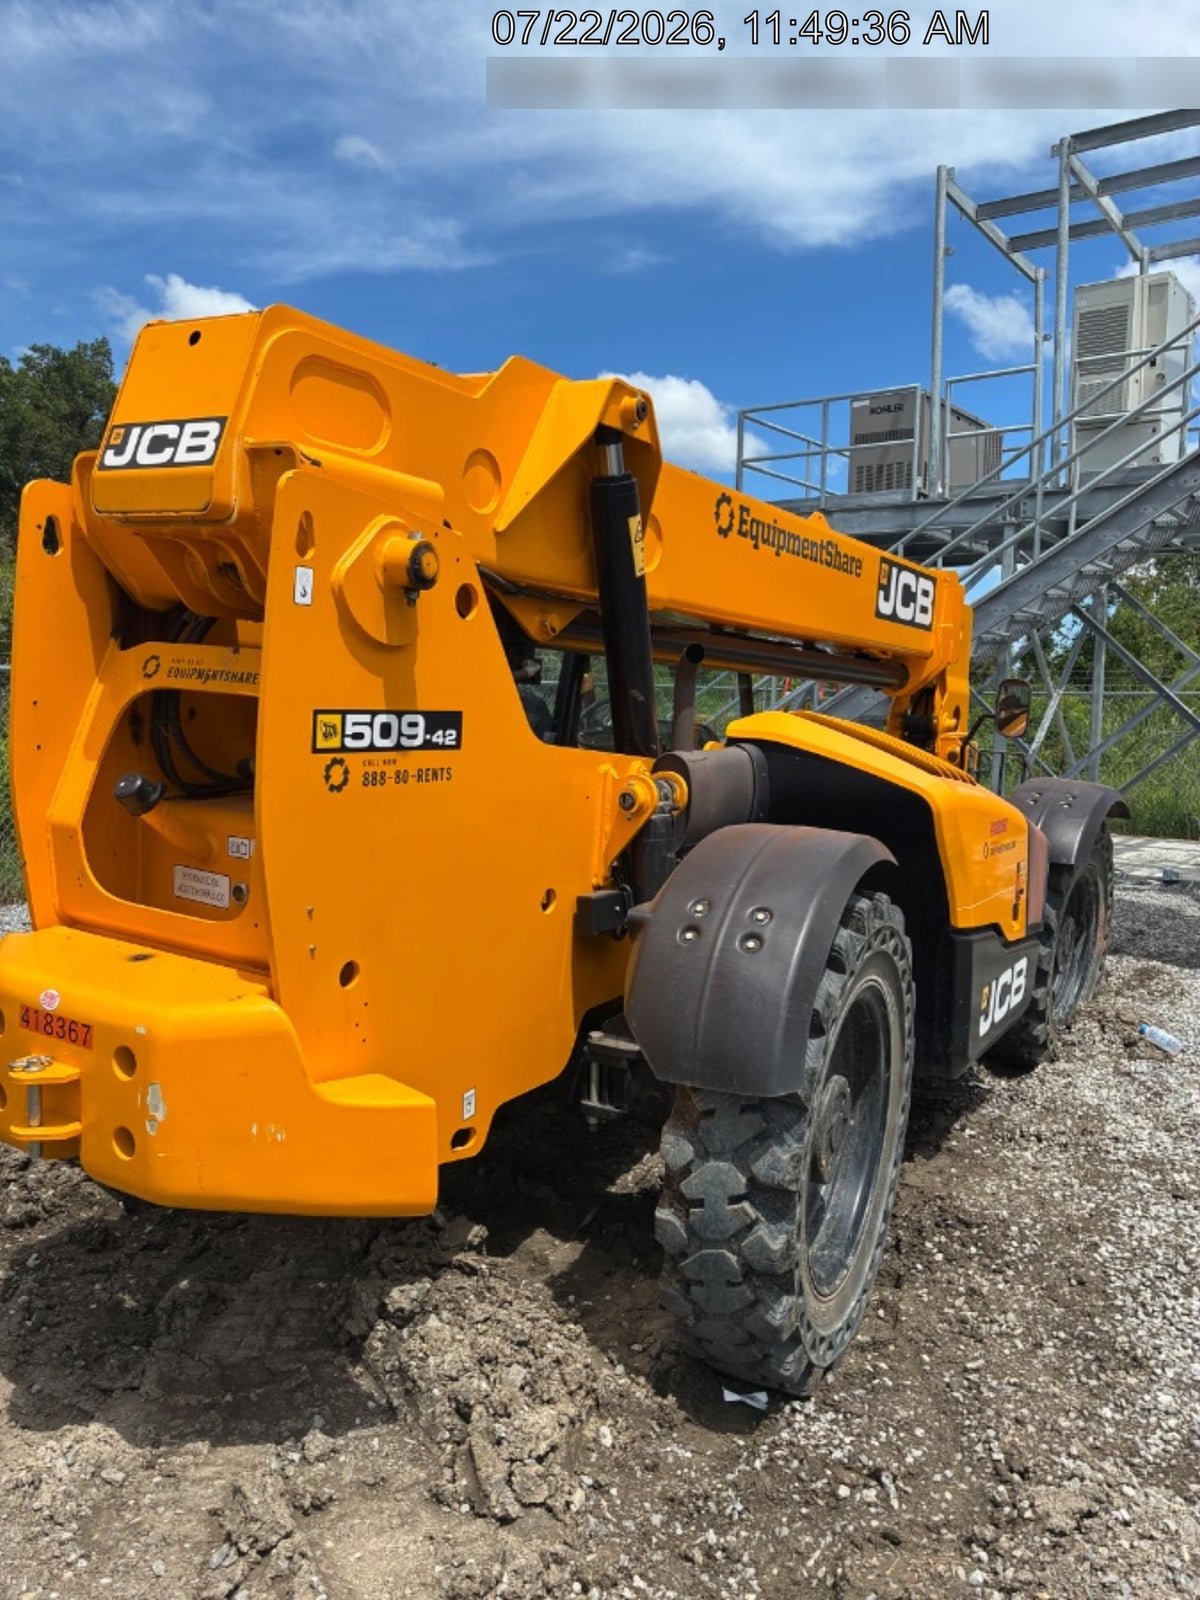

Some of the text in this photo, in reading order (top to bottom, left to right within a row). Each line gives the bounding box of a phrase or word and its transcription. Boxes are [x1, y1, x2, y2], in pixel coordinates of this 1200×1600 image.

[869, 402, 905, 416] KOHLER
[103, 420, 221, 467] JCB
[737, 504, 864, 578] EquipmentShare
[877, 565, 936, 627] JCB
[167, 666, 260, 685] EQUIPMENTSHARE
[362, 767, 453, 787] 888-80-RENTS
[978, 955, 1028, 1037] JCB
[21, 1006, 92, 1047] 418367
